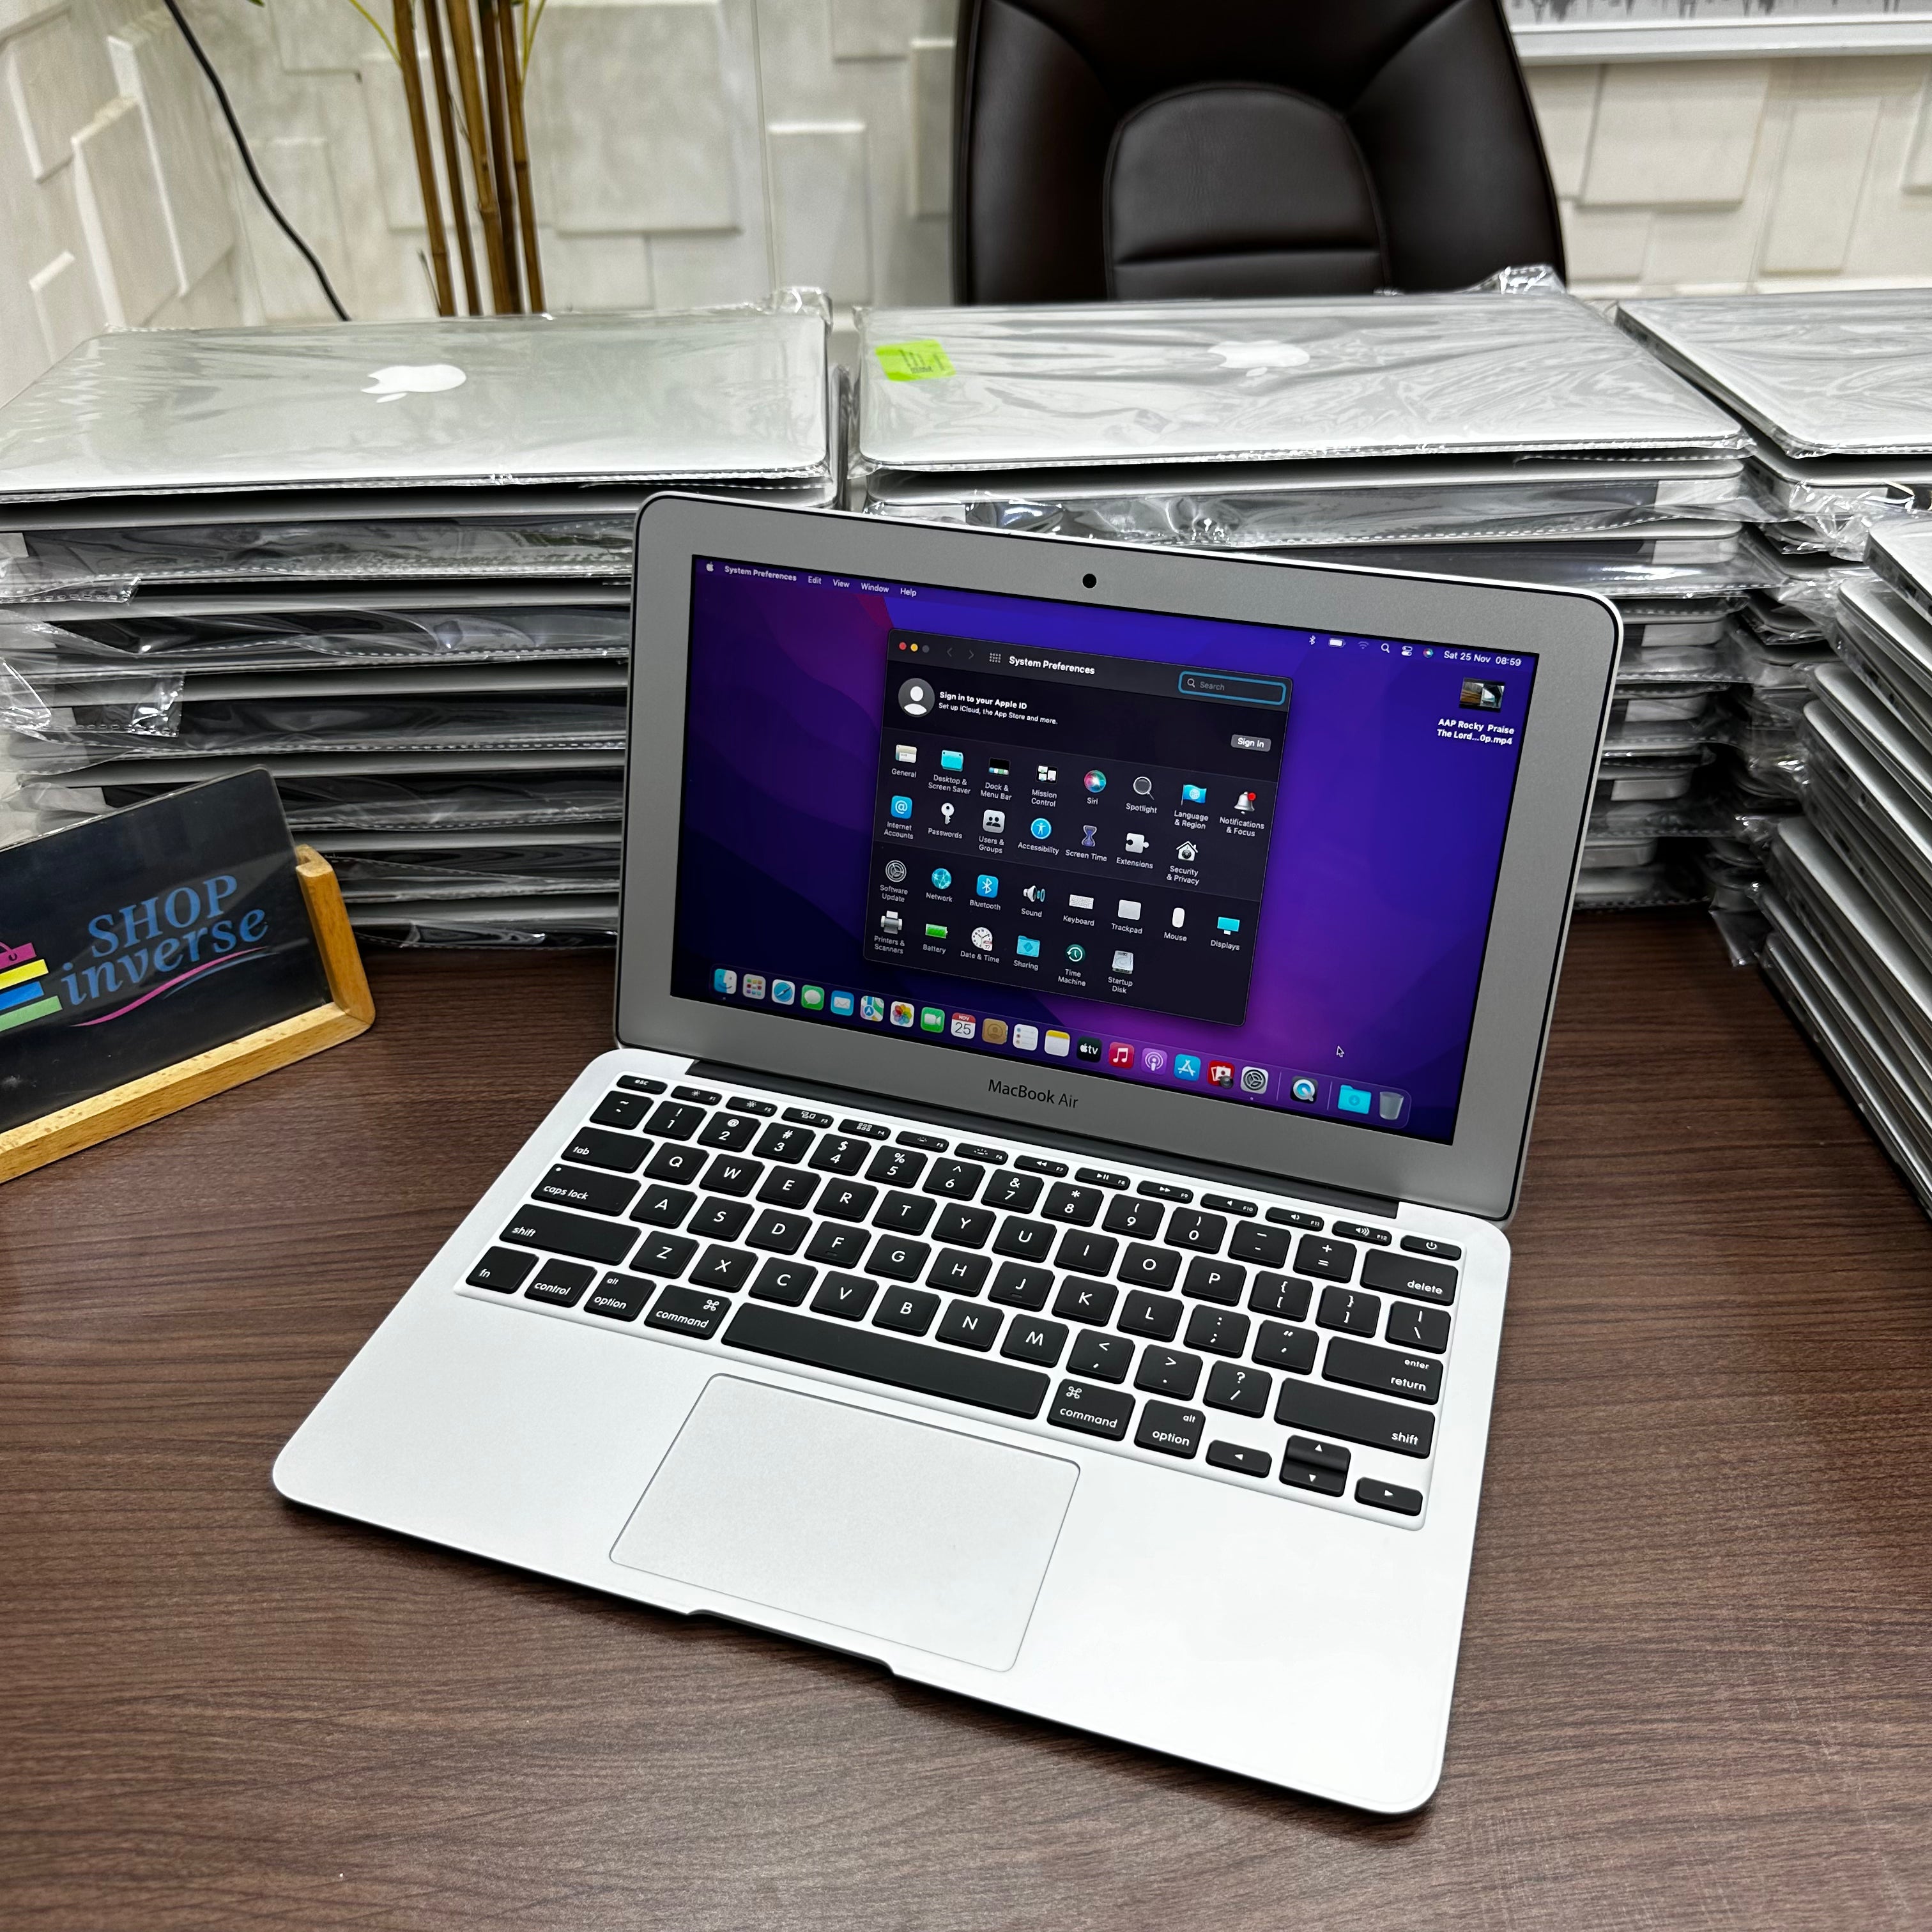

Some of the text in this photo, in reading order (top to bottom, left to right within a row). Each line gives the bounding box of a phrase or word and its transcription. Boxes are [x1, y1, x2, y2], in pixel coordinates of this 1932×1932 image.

[724, 566, 751, 575] System
[753, 569, 797, 581] Preferences
[808, 576, 822, 584] Edit
[861, 583, 889, 592] Window
[901, 588, 916, 597] Help
[1444, 651, 1521, 666] Sat 25 Nov 08:59
[1009, 656, 1094, 674] System Preferences
[1200, 682, 1224, 690] Search
[940, 692, 956, 700] Sign
[995, 700, 1017, 708] Apple
[1437, 729, 1452, 737] The
[1458, 721, 1484, 732] Rocky
[1487, 724, 1514, 734] Praise
[1238, 738, 1255, 747] Sign
[892, 769, 916, 778] General
[933, 774, 960, 785] Desktop
[928, 782, 951, 791] Screen
[981, 790, 999, 798] Menu
[1032, 789, 1057, 799] Mission
[1032, 798, 1055, 807] Control
[1126, 803, 1157, 813] Spotlight
[1174, 810, 1208, 822] Language
[887, 822, 912, 831] Internet
[1182, 820, 1206, 829] Region
[1220, 817, 1264, 829] Notifications
[884, 829, 913, 839] Accounts
[928, 828, 962, 838] Passwords
[1234, 828, 1255, 836] Focus
[979, 836, 997, 844] Users
[979, 845, 1002, 854] Groups
[1018, 842, 1059, 855] Accessibility
[1066, 850, 1089, 859] Screen
[1117, 857, 1153, 868] Extensions
[1170, 866, 1198, 877] Security
[1174, 875, 1199, 885] Privacy
[880, 885, 908, 894] Software
[882, 893, 905, 902] Update
[926, 893, 952, 902] Network
[970, 900, 1000, 910] Bluetooth
[88, 875, 237, 958] SHOP
[1022, 908, 1042, 917] Sound
[1063, 916, 1094, 926] Keyboard
[1112, 923, 1142, 933] Trackpad
[875, 935, 898, 946] Printers
[1164, 932, 1187, 941] Mouse
[875, 944, 905, 954] Scanners
[923, 944, 946, 954] Battery
[1211, 940, 1239, 951] Displays
[61, 908, 269, 1006] inverse
[1014, 960, 1038, 970] Sharing
[1058, 976, 1085, 986] Machine
[1108, 977, 1133, 987] Startup
[954, 1022, 971, 1035] 25
[1088, 1045, 1098, 1054] tv
[988, 1079, 1078, 1108] MacBook Air
[719, 1131, 730, 1140] 2
[573, 1146, 589, 1154] tab
[774, 1142, 785, 1151] 3
[670, 1156, 682, 1167] Q
[831, 1154, 841, 1163] 4
[724, 1167, 741, 1179] W
[887, 1166, 898, 1175] 5
[783, 1180, 795, 1190] E
[946, 1179, 954, 1188] 6
[544, 1184, 588, 1199] caps lock
[1005, 1190, 1015, 1199] 7
[840, 1192, 852, 1204] R
[655, 1199, 668, 1210] A
[1064, 1204, 1074, 1213] 8
[901, 1205, 911, 1216] T
[714, 1211, 726, 1222] S
[1128, 1217, 1136, 1226] 9
[772, 1223, 785, 1234] D
[962, 1218, 971, 1229] Y
[512, 1227, 535, 1236] shift
[1018, 1230, 1032, 1242] U
[832, 1237, 844, 1247] F
[657, 1246, 672, 1259] Z
[892, 1251, 905, 1262] G
[715, 1260, 731, 1272] X
[952, 1264, 967, 1276] H
[1143, 1259, 1156, 1270] O
[479, 1269, 490, 1277] fn
[1209, 1273, 1220, 1284] P
[778, 1274, 791, 1285] C
[1016, 1279, 1026, 1289] J
[535, 1281, 571, 1295] control
[1407, 1280, 1443, 1294] delete
[840, 1287, 852, 1300] V
[1078, 1292, 1092, 1305] K
[594, 1297, 626, 1309] option
[900, 1302, 912, 1314] B
[1146, 1307, 1154, 1319] L
[656, 1311, 709, 1328] command
[962, 1316, 977, 1330] N
[1026, 1331, 1043, 1346] M
[1405, 1360, 1429, 1369] enter
[1391, 1377, 1426, 1391] return
[1060, 1407, 1117, 1428] command
[1153, 1431, 1189, 1446] option
[1392, 1432, 1418, 1445] shift
